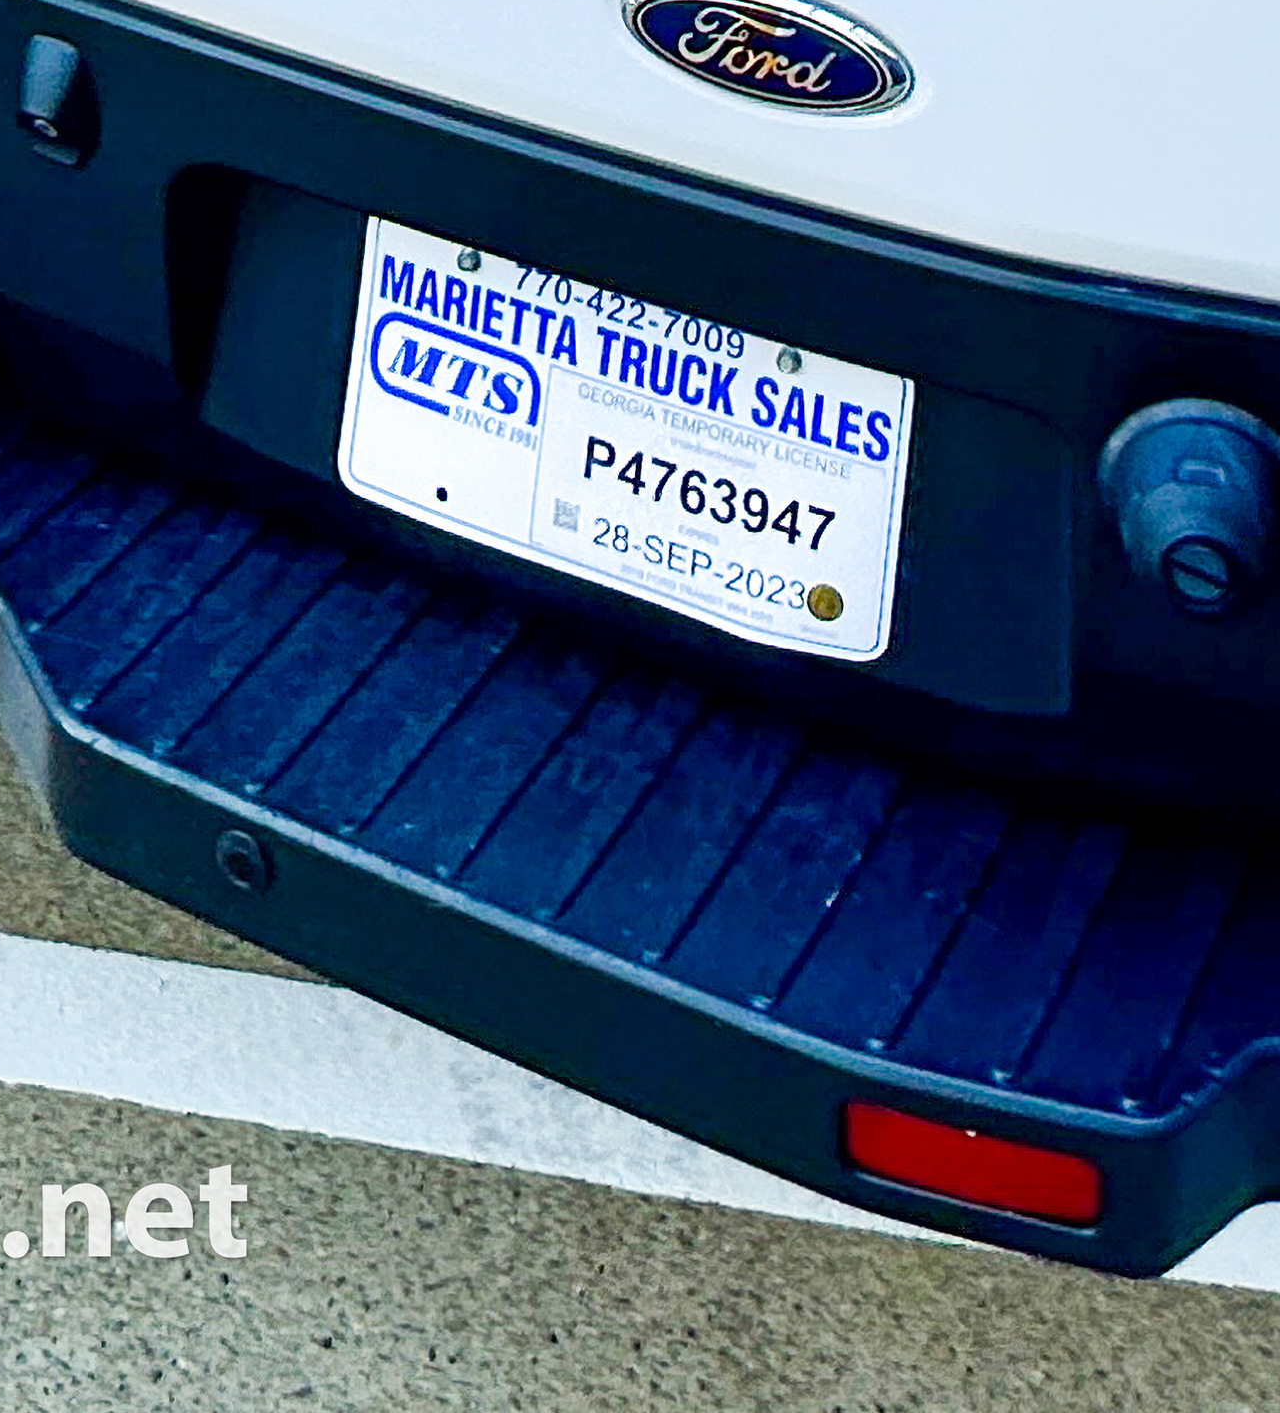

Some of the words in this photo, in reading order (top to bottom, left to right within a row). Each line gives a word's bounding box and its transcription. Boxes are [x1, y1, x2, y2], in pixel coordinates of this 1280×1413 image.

[677, 6, 837, 93] Ford
[380, 254, 578, 367] MARIETTA
[597, 325, 740, 417] TRUCK
[751, 375, 894, 462] SALES
[516, 264, 746, 360] 770-422-7009
[387, 335, 526, 416] MTS
[452, 404, 508, 439] SINCE
[577, 381, 657, 422] GEORGIA
[662, 410, 773, 457] TEMPORARY
[774, 442, 852, 480] LICENSE
[583, 436, 836, 551] P4763947
[592, 517, 807, 610] 28-SEP-2023
